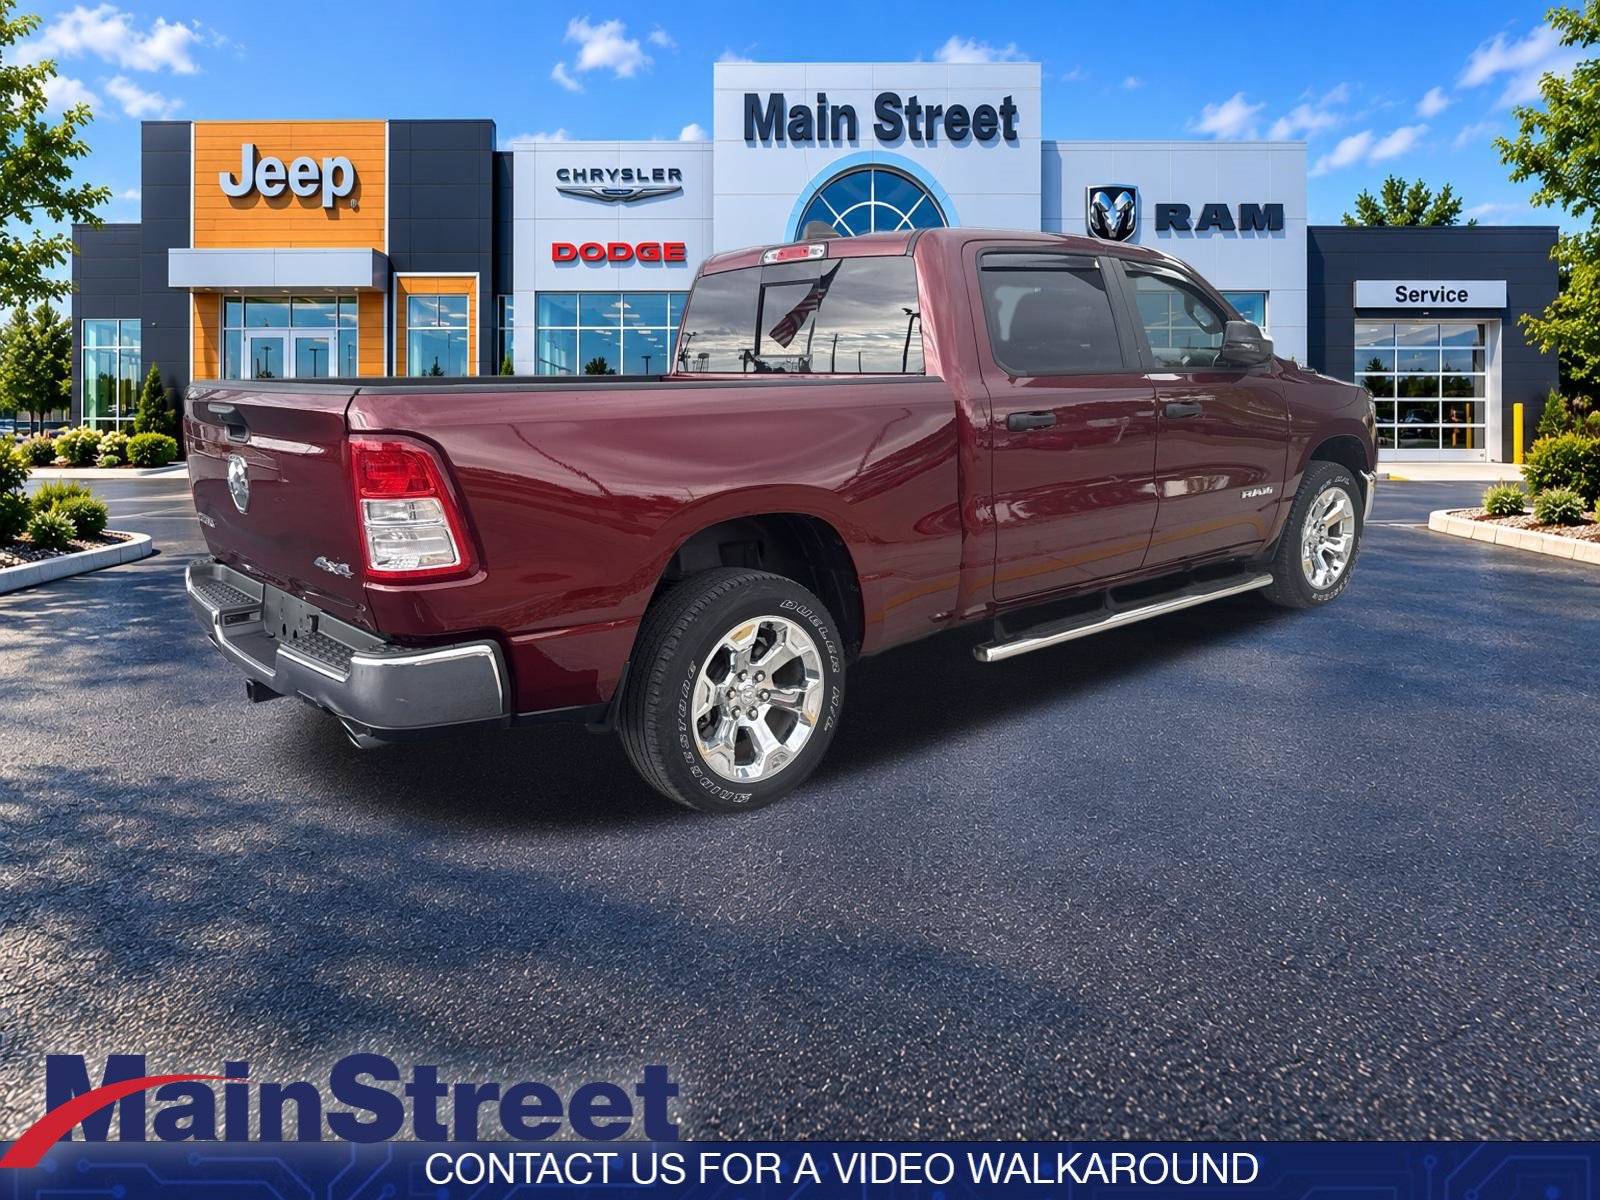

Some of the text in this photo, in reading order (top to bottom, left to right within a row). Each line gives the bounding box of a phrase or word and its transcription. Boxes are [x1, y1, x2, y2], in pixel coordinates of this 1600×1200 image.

[744, 91, 1018, 141] Main Street
[218, 143, 355, 208] Jeep
[556, 167, 683, 182] CHRYSLER
[1155, 203, 1284, 231] RAM
[552, 242, 686, 262] DODGE
[1395, 285, 1469, 303] Service
[1241, 486, 1273, 499] RAM
[780, 600, 840, 673] DUELER
[678, 660, 752, 803] BRIDGESTONE
